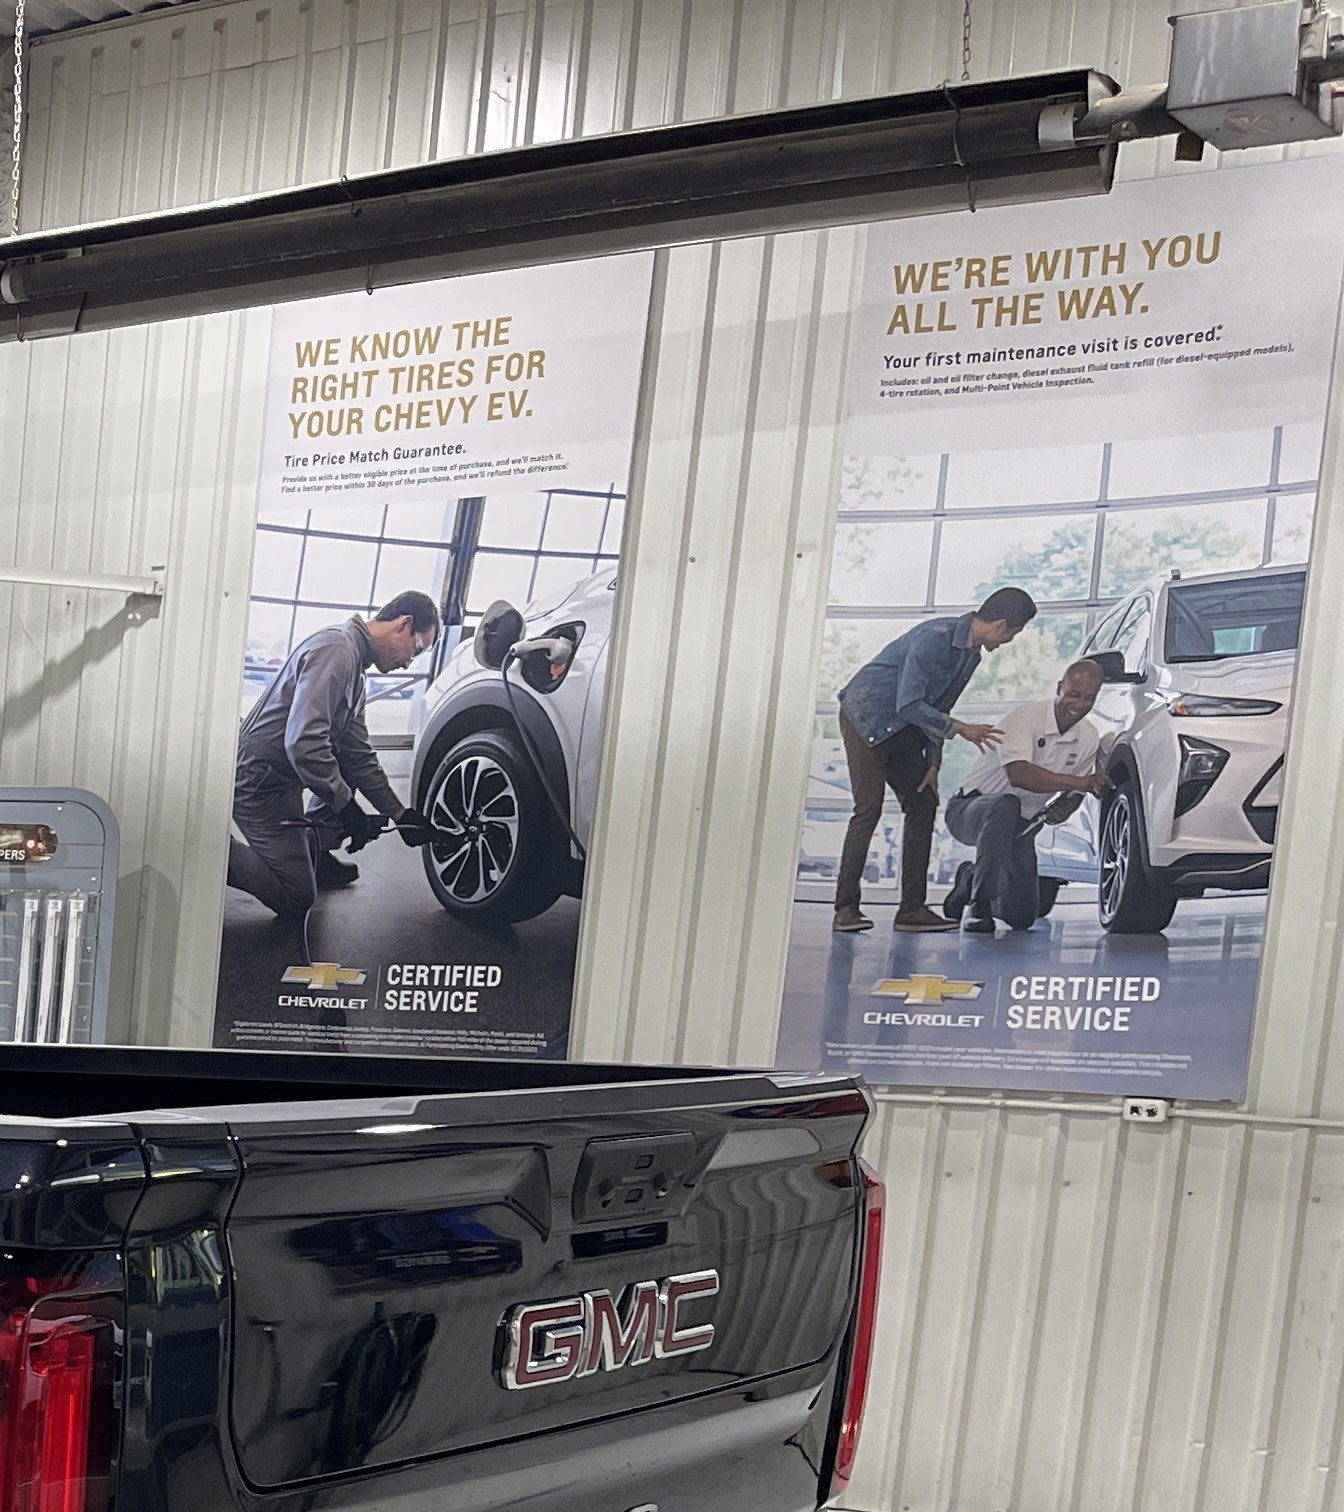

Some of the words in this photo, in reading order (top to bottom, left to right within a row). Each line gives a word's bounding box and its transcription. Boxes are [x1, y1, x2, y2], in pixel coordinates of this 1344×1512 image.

[893, 254, 1013, 295] WE'RE
[1025, 242, 1127, 284] WITH
[1141, 230, 1222, 271] YOU
[886, 300, 957, 336] ALL
[971, 292, 1044, 329] THE
[1057, 282, 1150, 322] WAY.
[295, 337, 341, 368] WE
[350, 325, 442, 363] KNOW
[452, 315, 513, 351] THE
[883, 354, 920, 370] Your
[925, 351, 962, 367] first
[966, 343, 1077, 365] maintenance
[1081, 335, 1119, 354] visit
[1123, 335, 1138, 350] is
[290, 369, 379, 404] RIGHT
[389, 358, 474, 394] TIRES
[486, 349, 546, 384] FOR
[933, 375, 949, 384] and
[1022, 367, 1049, 378] diesel
[1050, 364, 1086, 376] exhaust
[944, 385, 960, 395] and
[1012, 379, 1044, 390] Vehicle
[288, 407, 363, 440] YOUR
[374, 394, 478, 434] CHEVY
[488, 389, 534, 421] EV.
[284, 454, 309, 468] Tire
[312, 452, 346, 466] Price
[349, 448, 389, 464] Match
[393, 443, 466, 460] Guarantee.
[387, 964, 502, 987] CERTIFIED
[384, 990, 479, 1013] SERVICE
[1010, 976, 1160, 1002] CERTIFIED
[278, 995, 368, 1010] CHEVROLET
[863, 1011, 984, 1028] CHEVROLET
[1007, 1006, 1131, 1032] SERVICE
[492, 1269, 719, 1391] GMC
